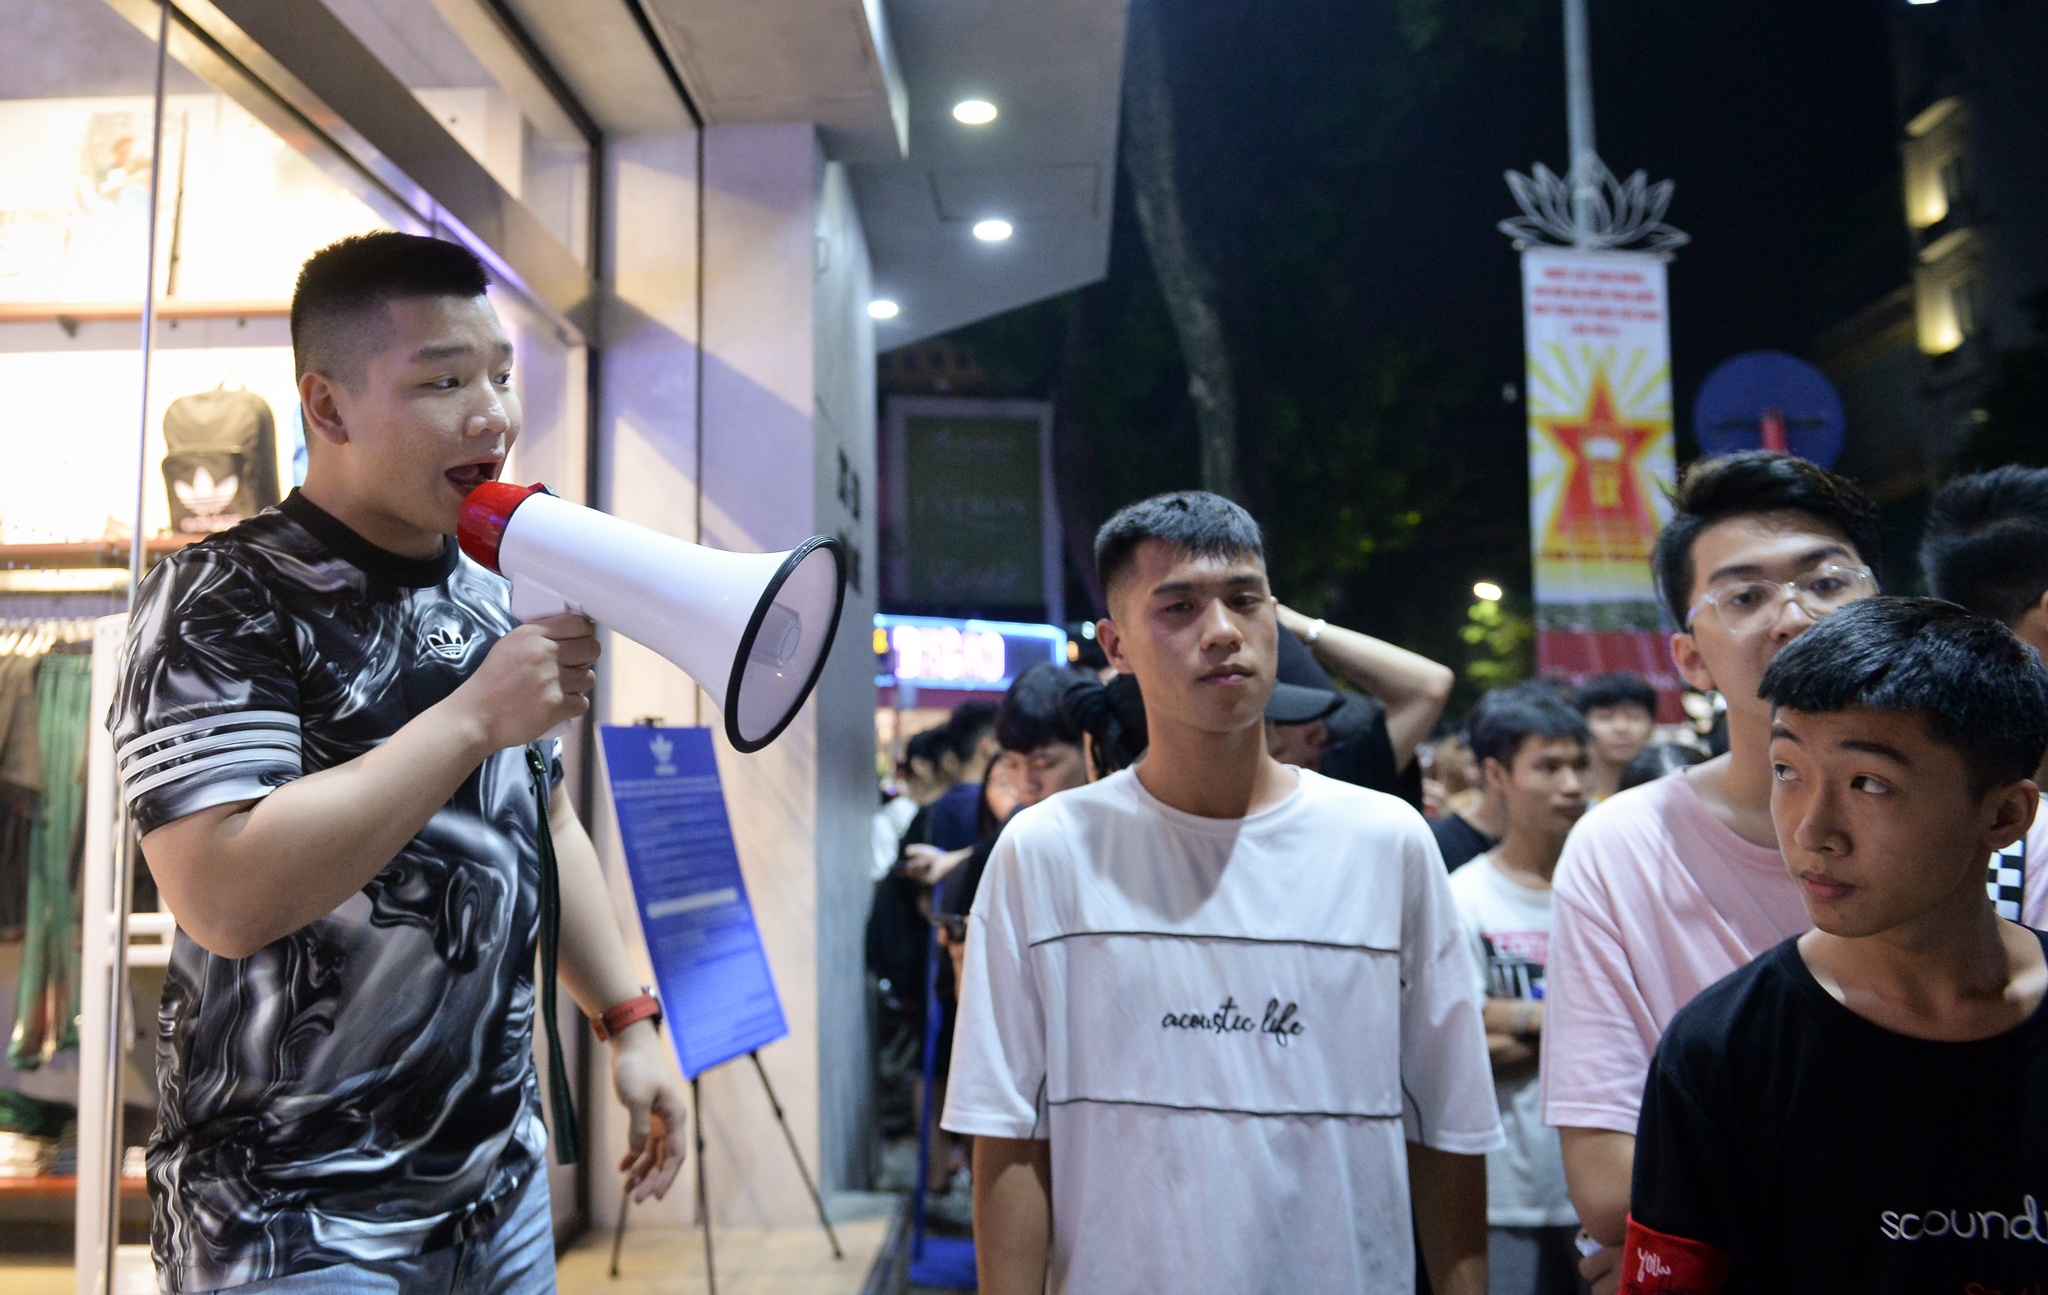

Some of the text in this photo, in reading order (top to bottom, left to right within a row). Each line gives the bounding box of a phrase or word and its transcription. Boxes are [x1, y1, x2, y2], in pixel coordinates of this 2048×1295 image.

[1162, 996, 1305, 1047] acoustic life
[1880, 1193, 2048, 1245] scound
